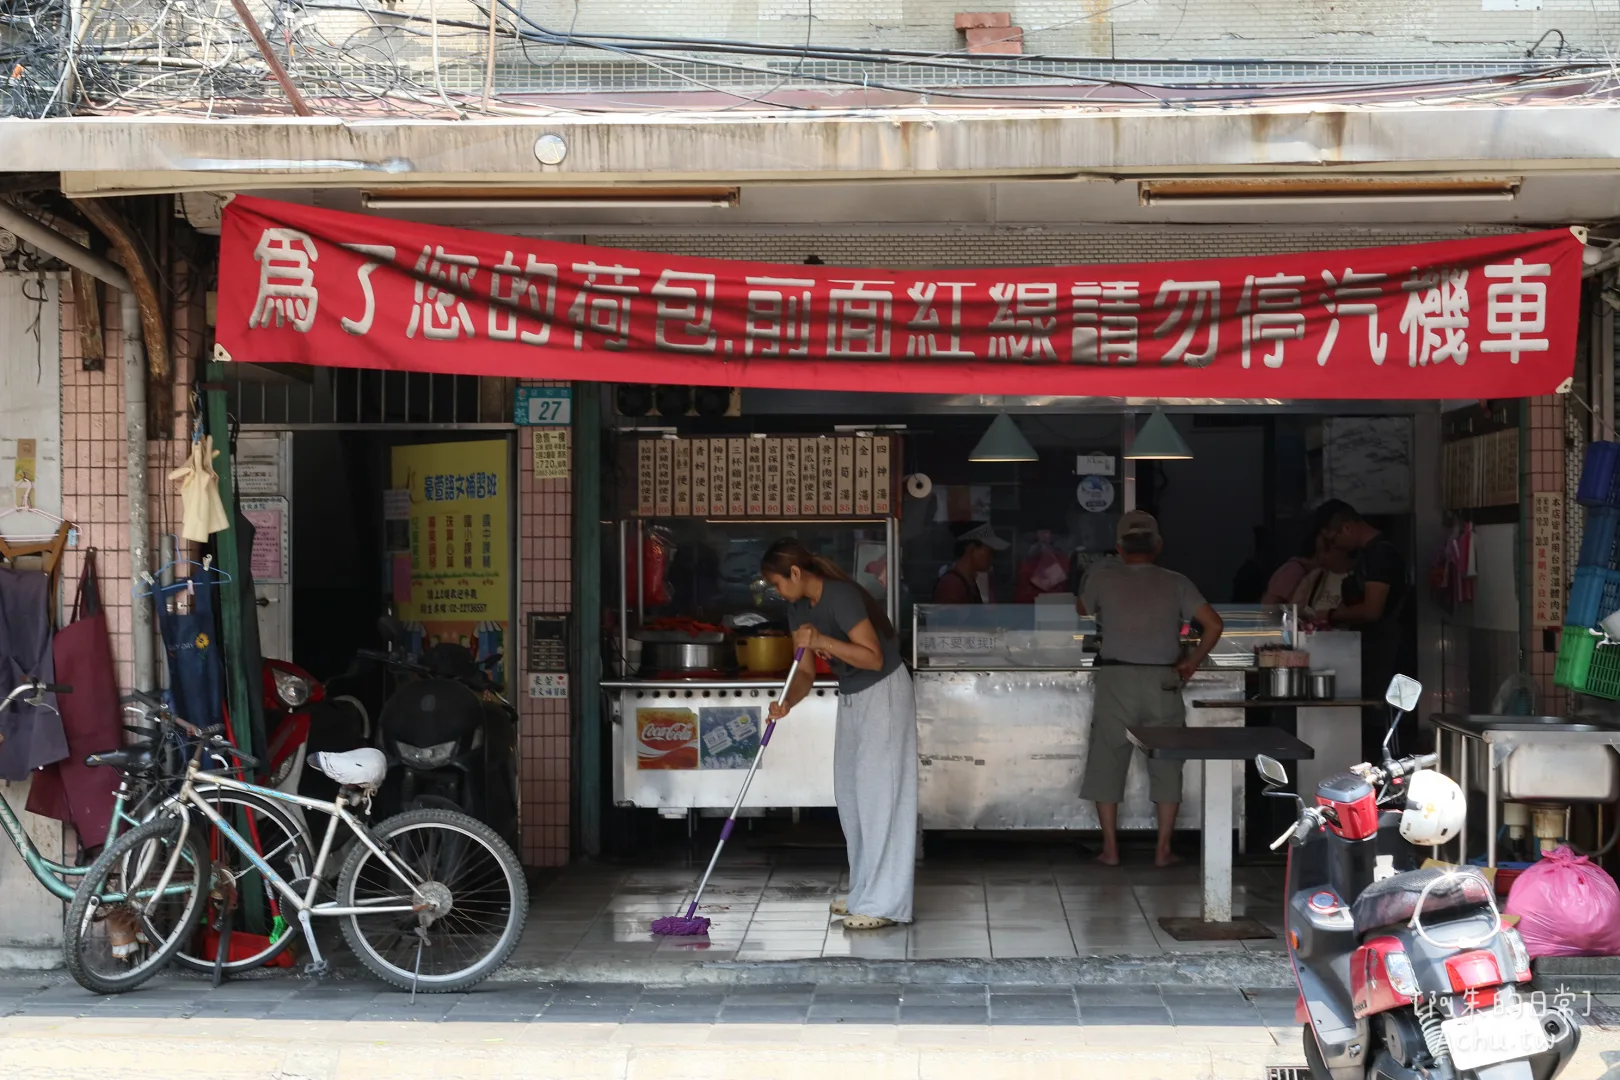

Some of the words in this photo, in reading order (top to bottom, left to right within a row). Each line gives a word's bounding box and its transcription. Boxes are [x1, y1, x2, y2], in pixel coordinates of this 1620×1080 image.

[538, 401, 563, 420] 27
[731, 446, 742, 501] 三杯雞便當
[695, 504, 707, 513] 95
[713, 504, 725, 513] 90
[731, 504, 743, 513] 95
[750, 504, 761, 513] 90
[767, 504, 778, 513] 90
[786, 504, 797, 513] 85
[803, 504, 815, 513] 80
[822, 504, 833, 513] 90
[840, 503, 850, 512] 35
[858, 504, 869, 513] 35
[876, 503, 887, 512] 50
